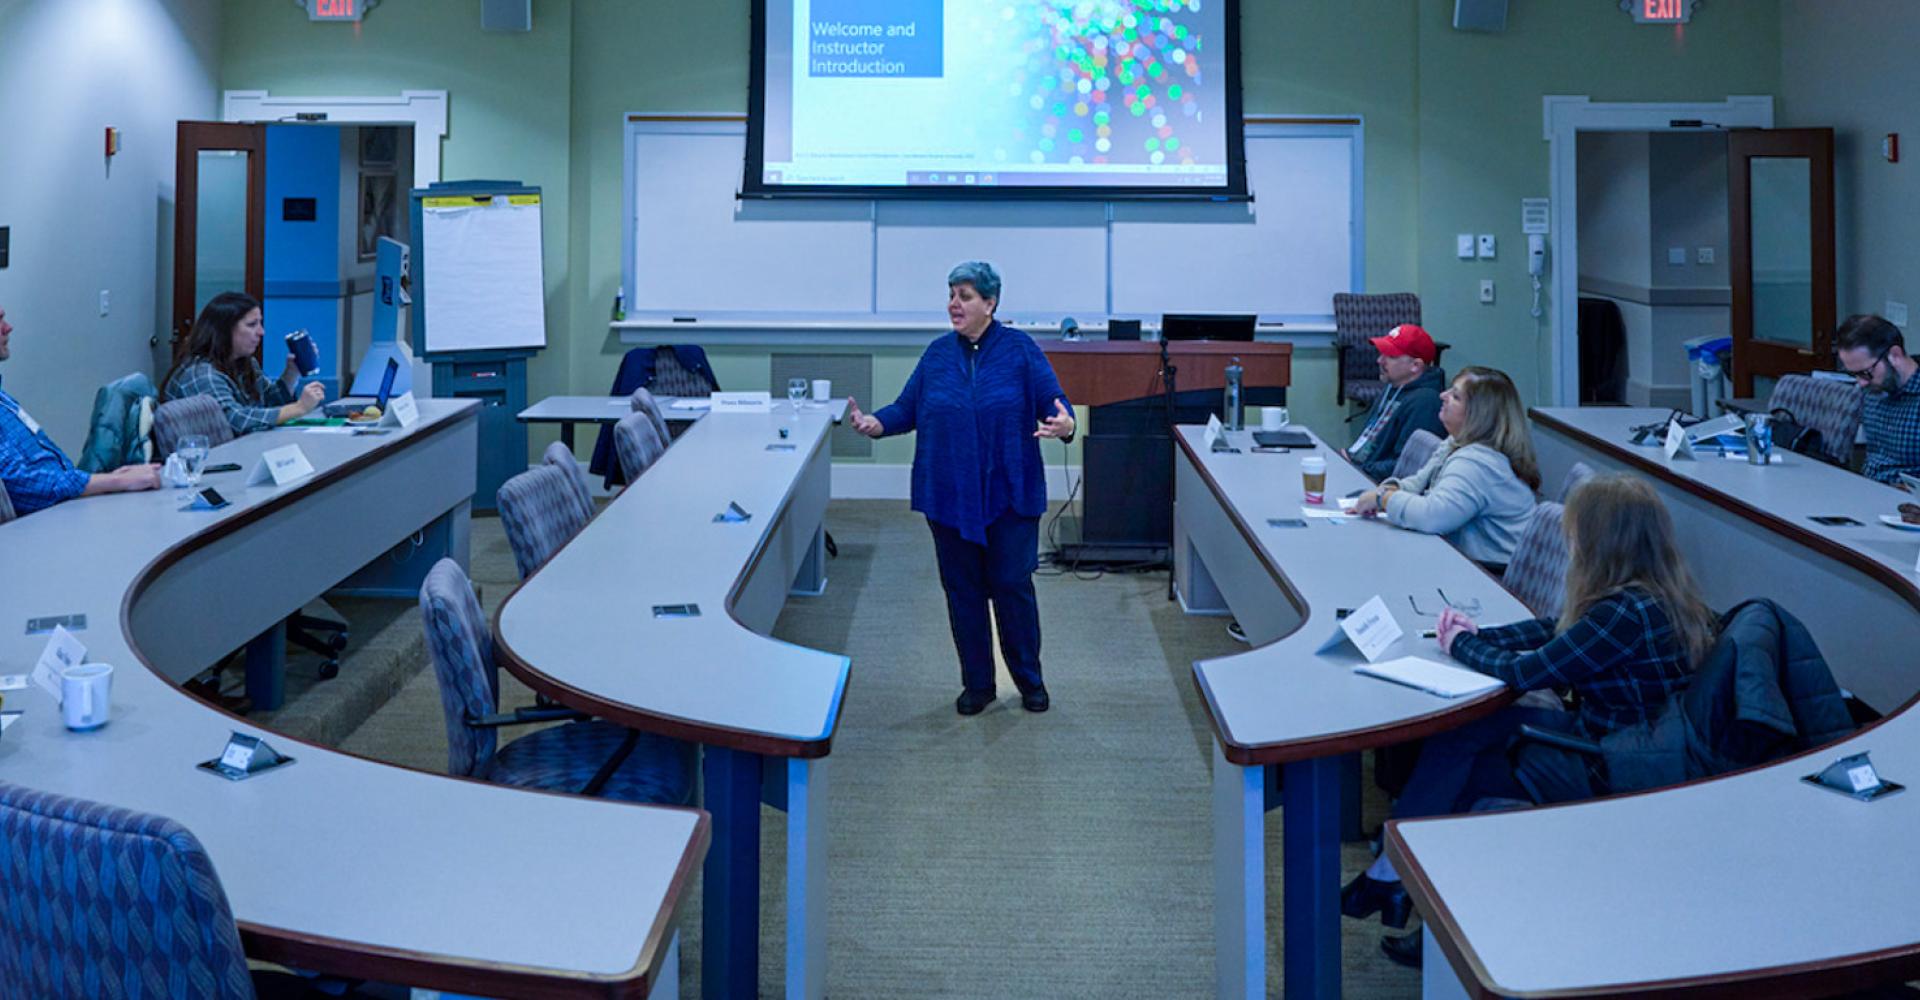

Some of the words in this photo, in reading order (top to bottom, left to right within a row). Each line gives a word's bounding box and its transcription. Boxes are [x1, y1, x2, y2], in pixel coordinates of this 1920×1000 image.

[1644, 0, 1682, 19] EXIT
[811, 22, 882, 36] Welcome
[886, 22, 915, 36] and
[812, 41, 885, 55] Instructor
[812, 59, 905, 73] Introduction
